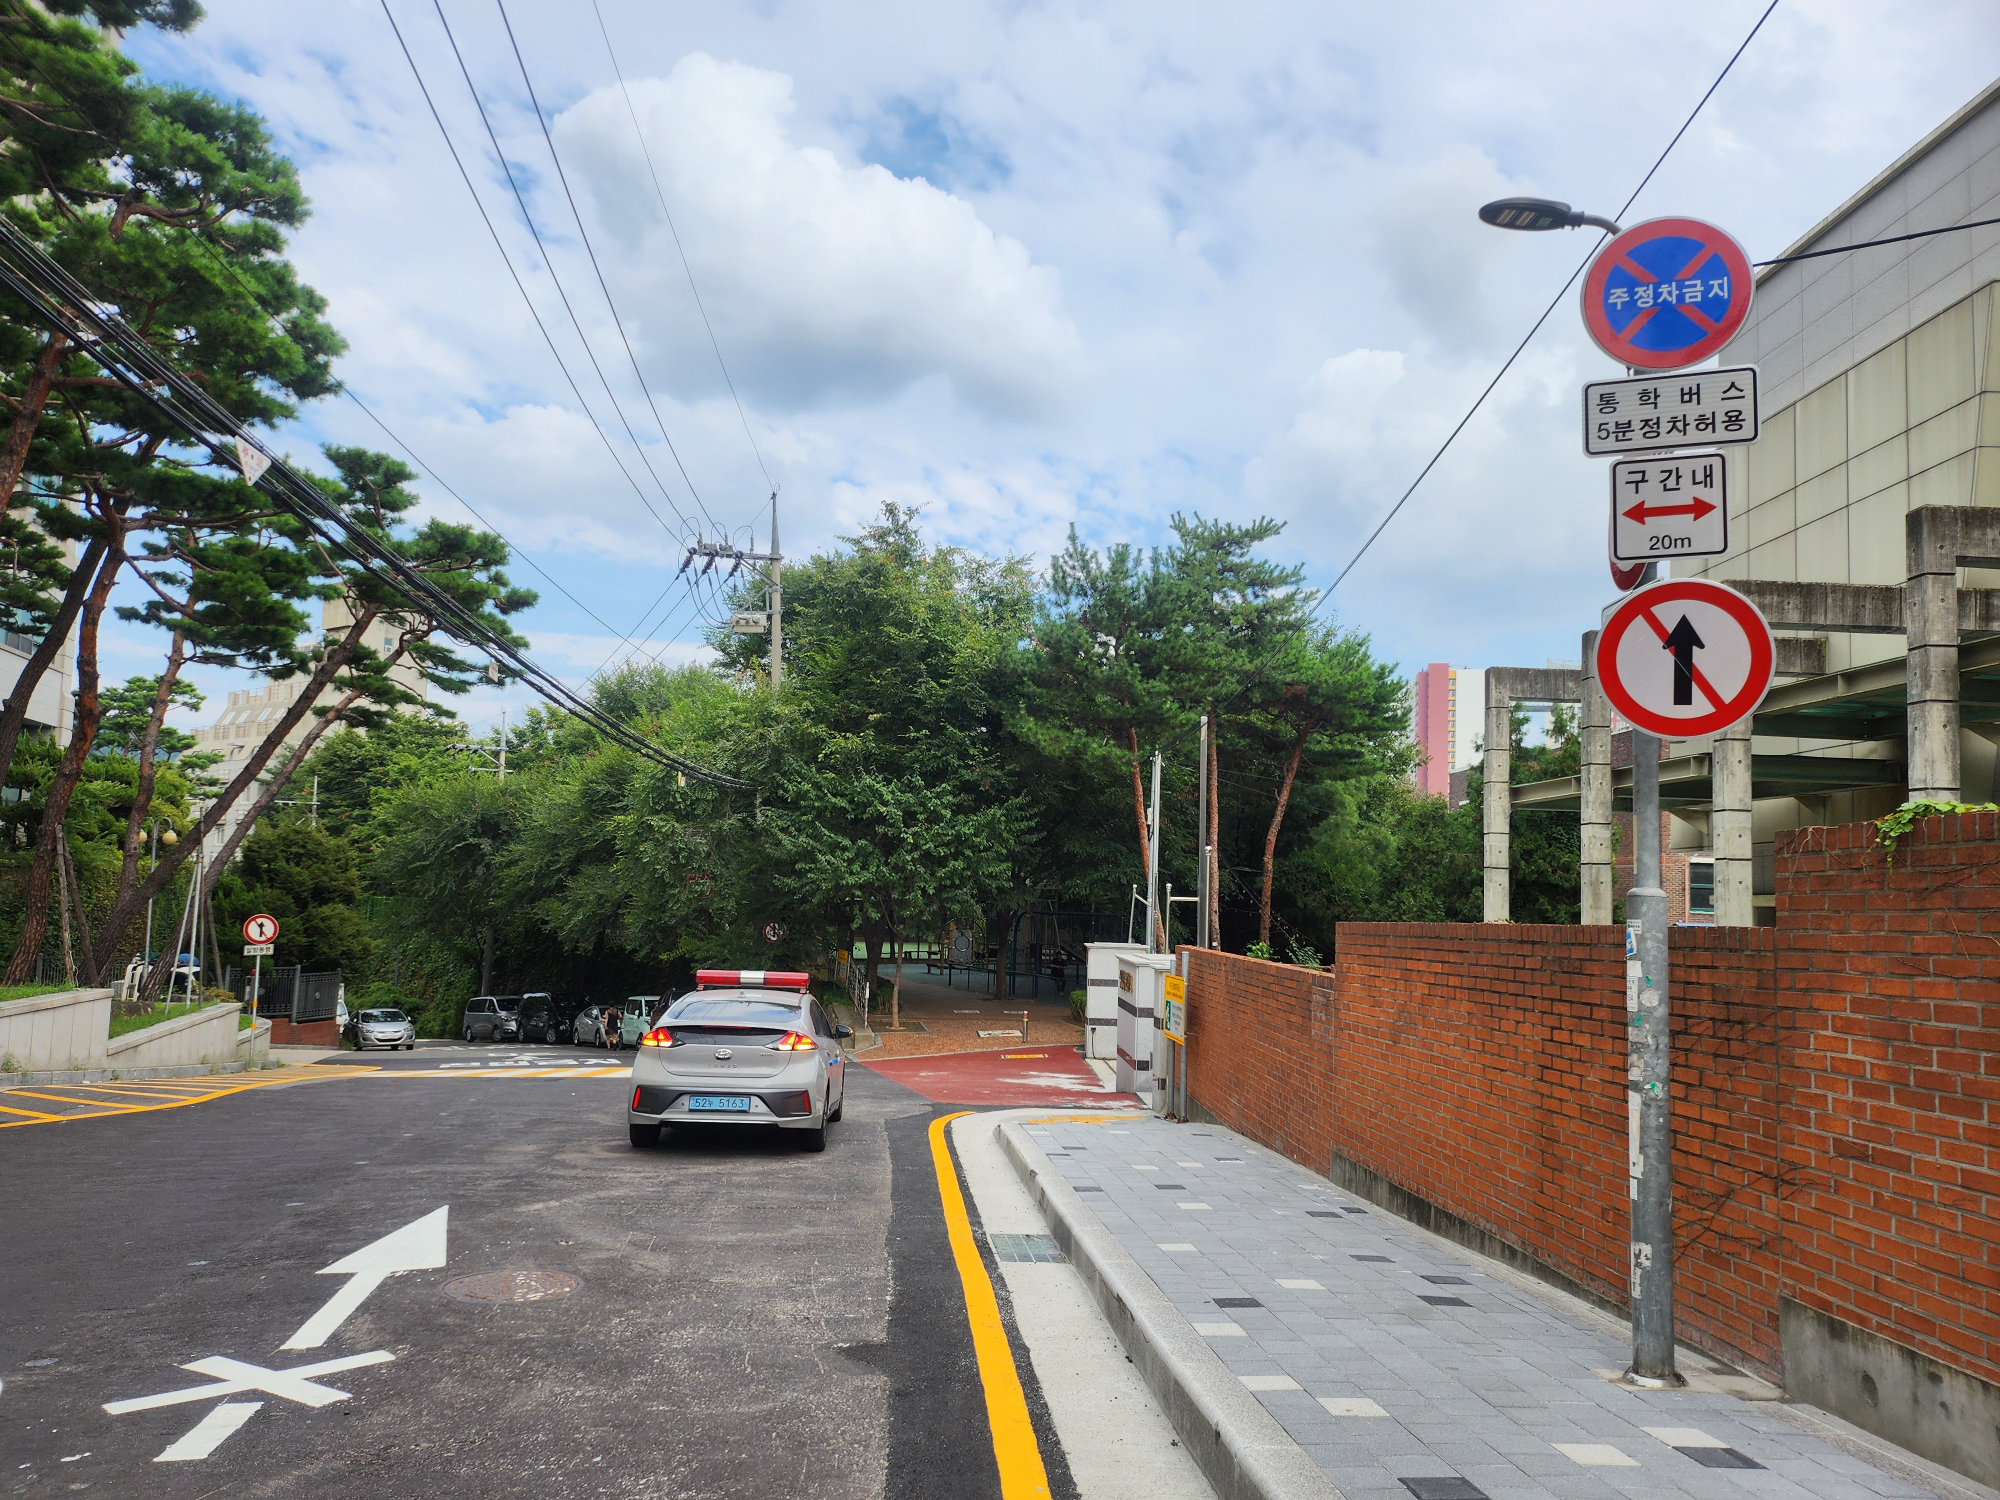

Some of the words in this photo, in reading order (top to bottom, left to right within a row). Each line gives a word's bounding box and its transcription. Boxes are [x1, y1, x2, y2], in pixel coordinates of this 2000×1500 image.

[1607, 276, 1729, 311] 주정차금지
[1597, 408, 1746, 443] 5분정차허용
[1648, 534, 1692, 551] 20m
[718, 1098, 745, 1109] 5163
